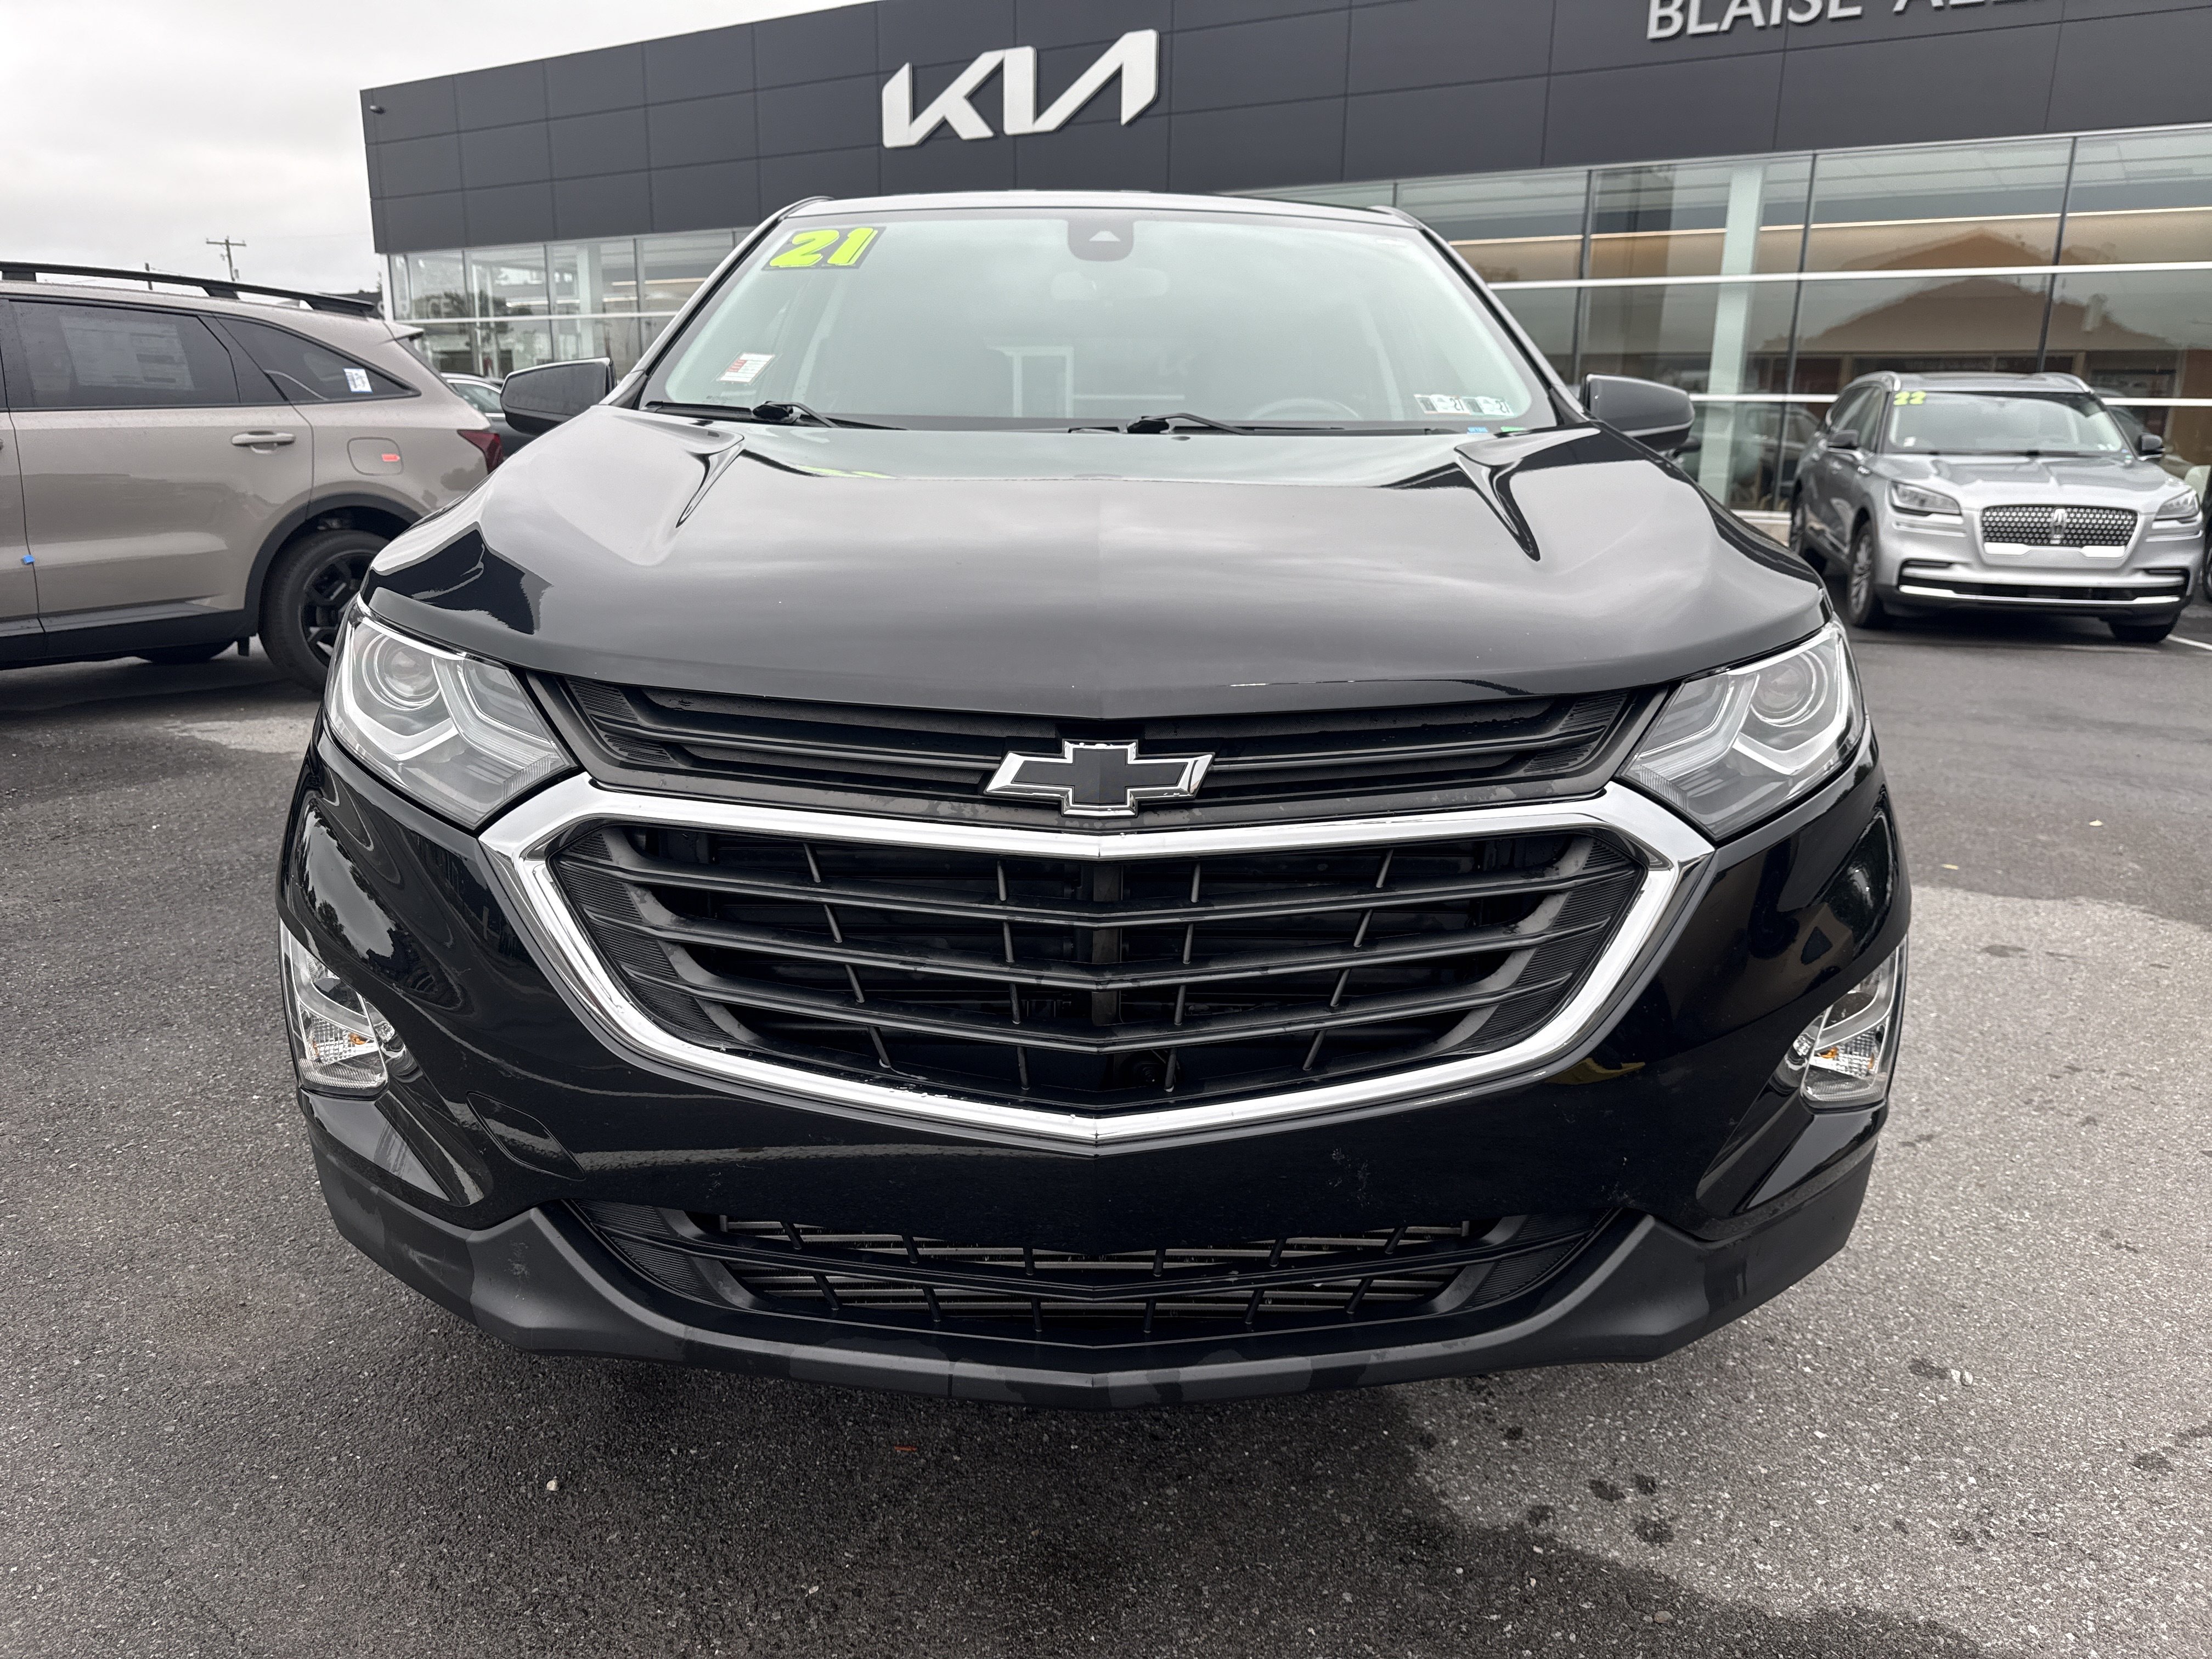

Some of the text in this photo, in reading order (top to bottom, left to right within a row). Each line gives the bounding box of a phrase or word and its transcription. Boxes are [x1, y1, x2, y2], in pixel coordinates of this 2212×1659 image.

[882, 29, 1159, 148] KIA
[770, 228, 878, 267] 21
[1893, 391, 1926, 405] 22
